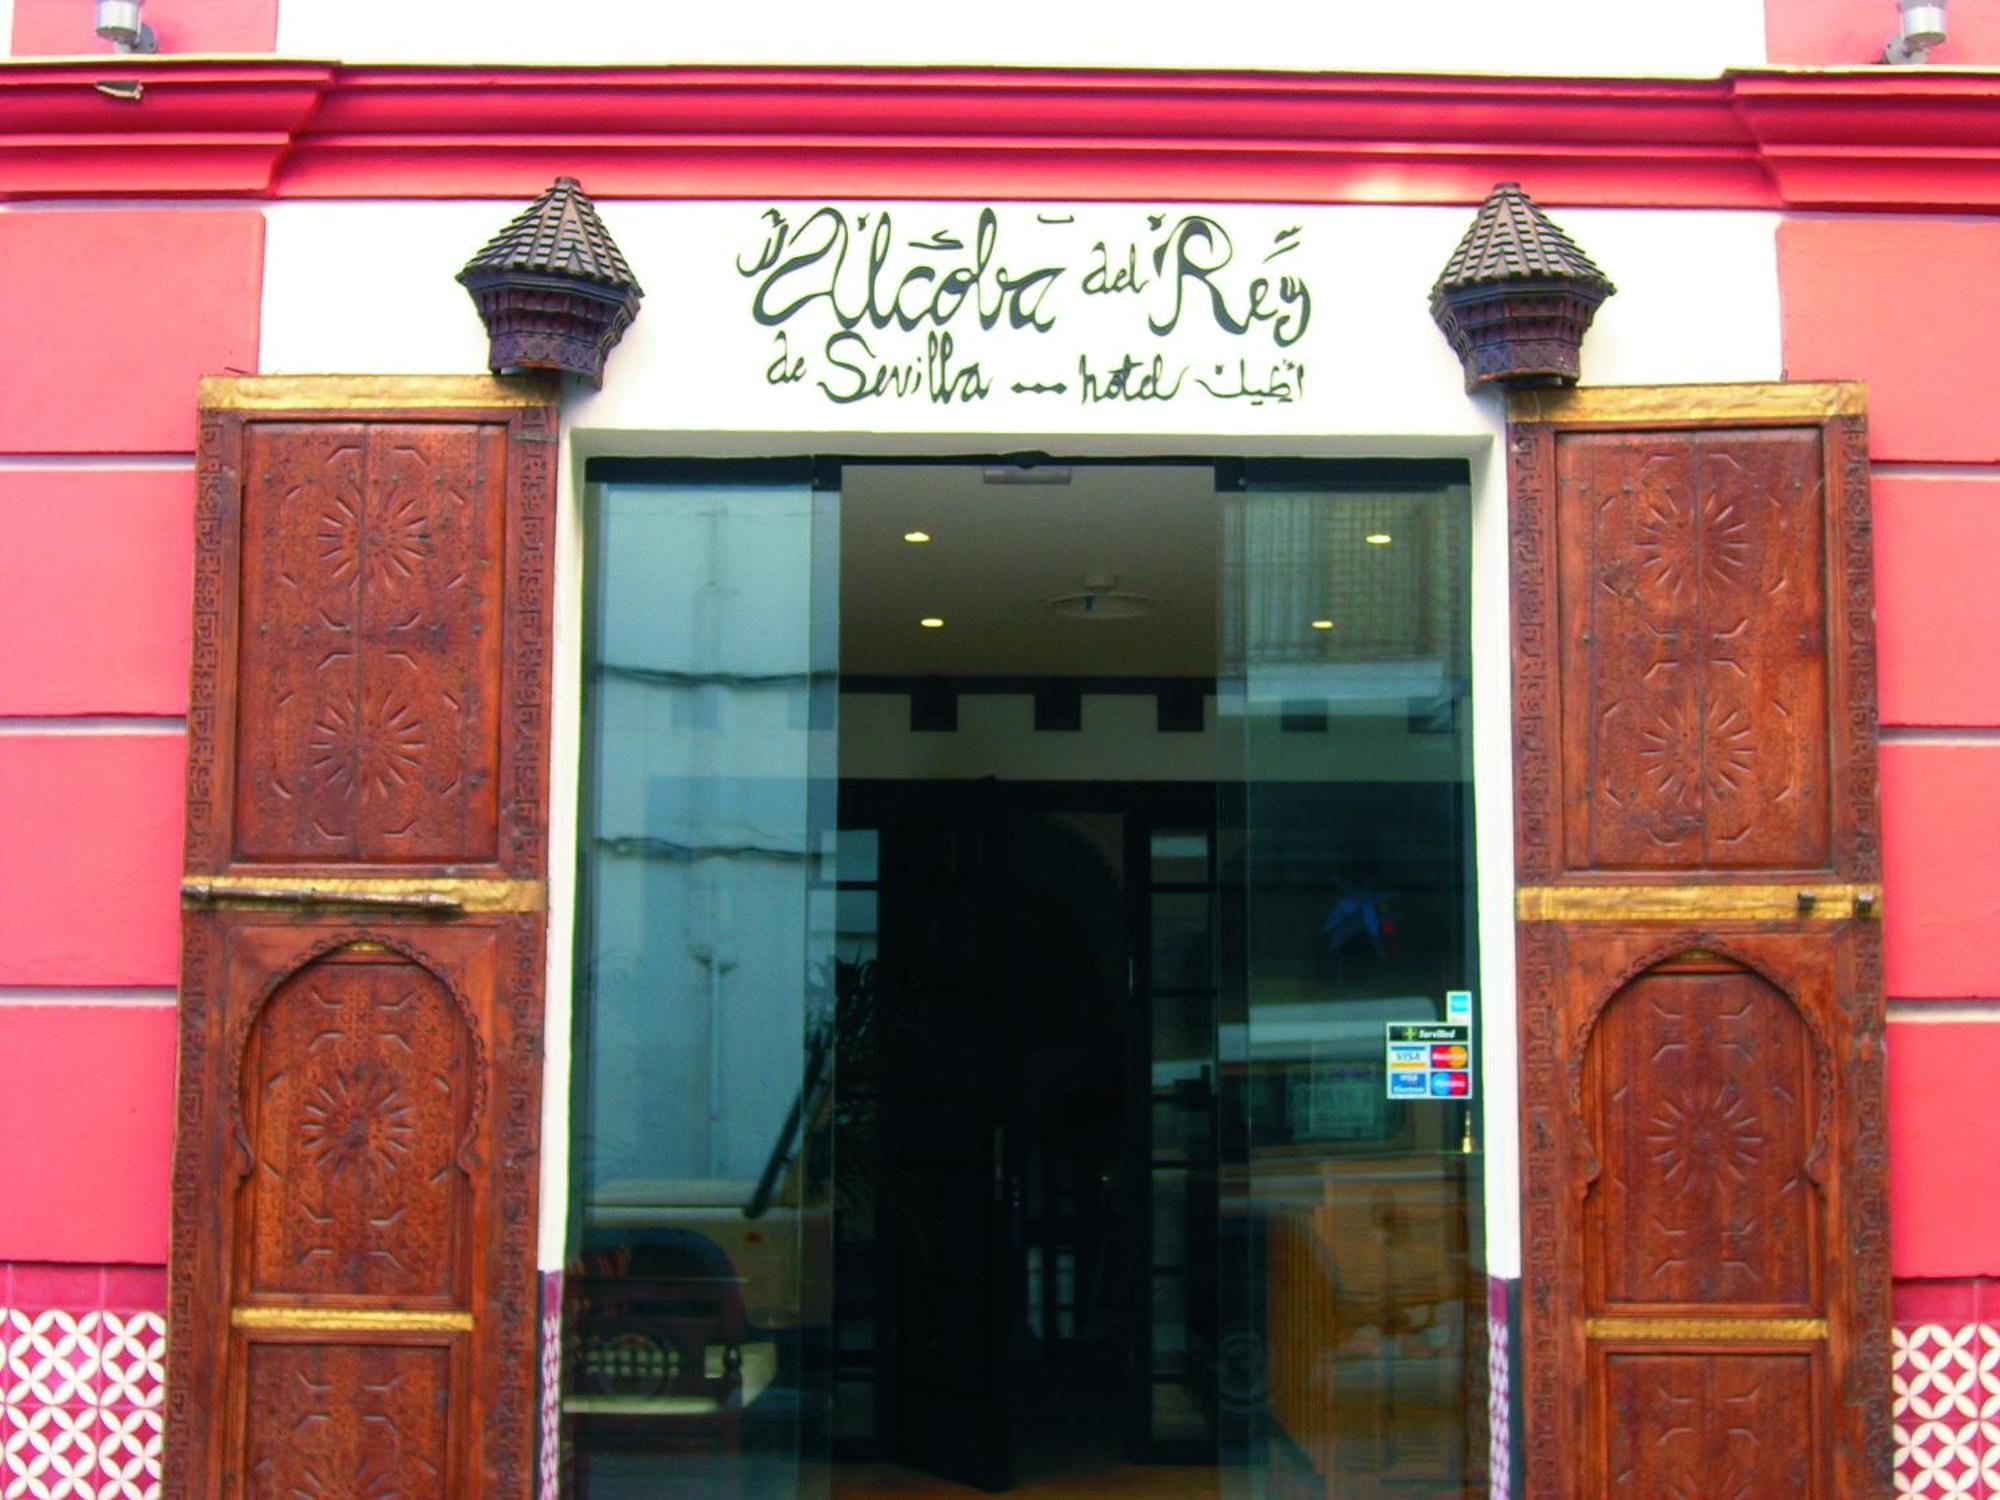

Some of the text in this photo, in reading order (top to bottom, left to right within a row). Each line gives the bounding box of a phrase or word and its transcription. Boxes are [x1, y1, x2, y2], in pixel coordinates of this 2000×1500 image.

[1081, 240, 1150, 294] del
[766, 330, 1189, 404] de Sevilla hotel
[1396, 1052, 1421, 1061] VISA
